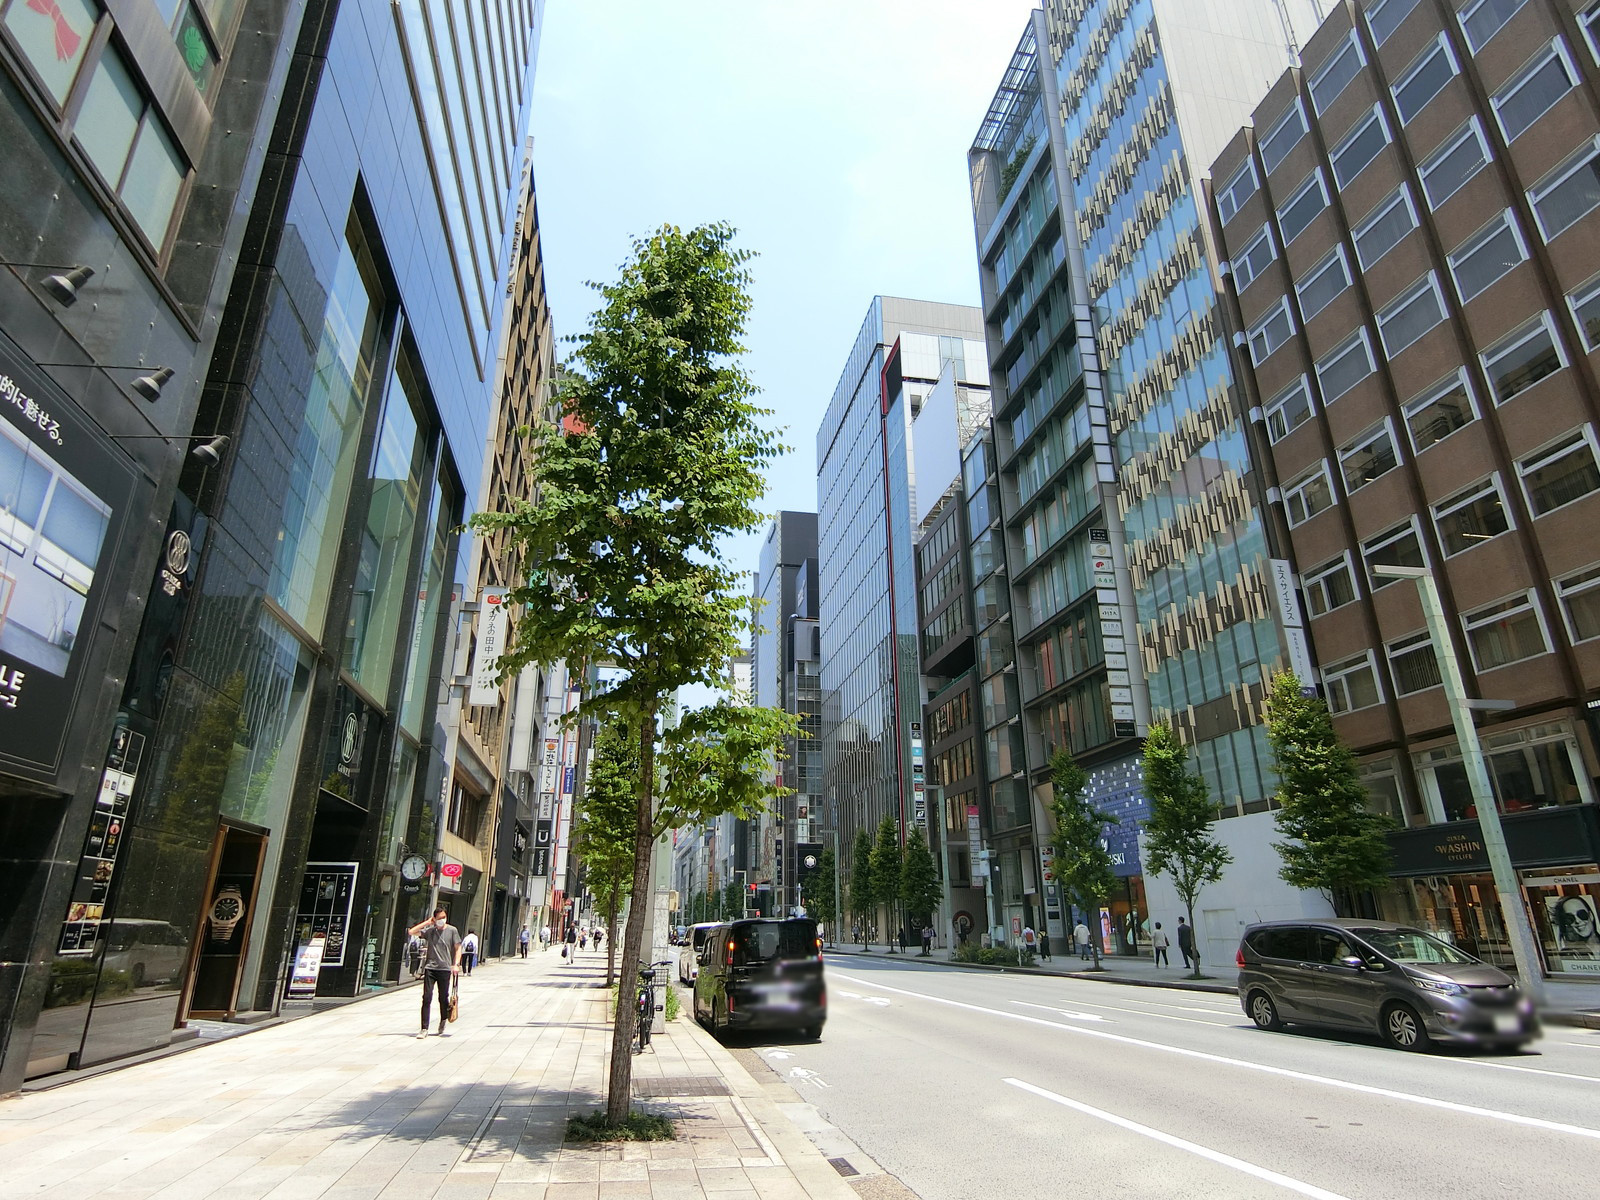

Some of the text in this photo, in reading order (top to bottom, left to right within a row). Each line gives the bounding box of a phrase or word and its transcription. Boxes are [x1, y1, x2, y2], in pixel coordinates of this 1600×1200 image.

[0, 374, 63, 446] 的に魅せる。
[1434, 841, 1481, 854] WASHIN
[1553, 876, 1579, 884] CHANEL
[1571, 963, 1600, 971] CHANE
